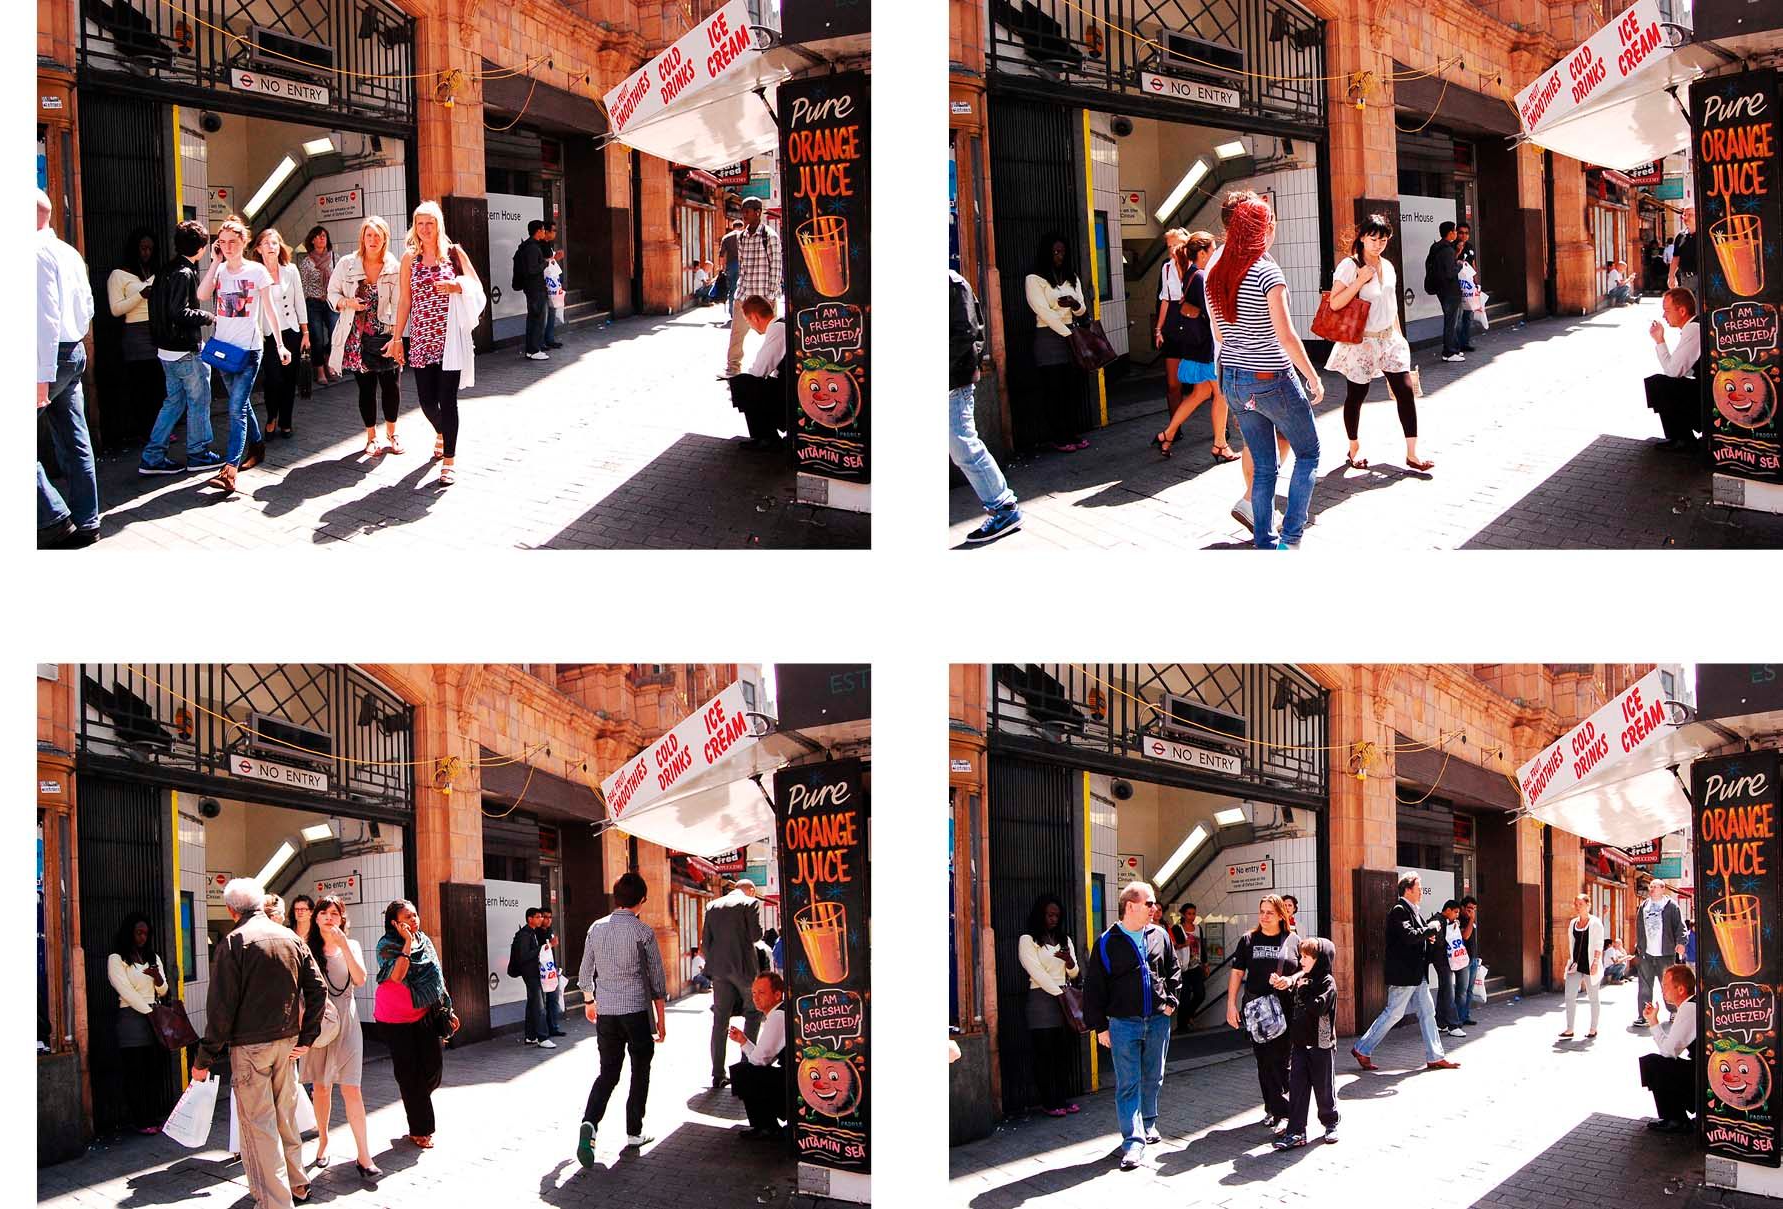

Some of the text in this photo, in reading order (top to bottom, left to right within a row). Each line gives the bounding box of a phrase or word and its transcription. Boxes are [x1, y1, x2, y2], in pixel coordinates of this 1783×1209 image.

[707, 13, 729, 48] ICE
[1618, 10, 1640, 46] ICE
[658, 47, 681, 81] COLD
[707, 25, 751, 78] CREAM
[1569, 46, 1592, 80] COLD
[1618, 23, 1662, 76] CREAM
[261, 78, 322, 100] NO ENTRY
[660, 58, 695, 104] DRINKS
[1171, 82, 1232, 104] NO ENTRY
[1572, 57, 1606, 103] DRINKS
[616, 71, 651, 130] SMOOTHIES
[792, 96, 854, 128] Pure
[1527, 71, 1562, 130] SMOOTHIES
[1704, 94, 1767, 126] Pure
[789, 126, 860, 163] ORANGE
[1702, 124, 1774, 162] ORANGE
[794, 163, 853, 197] JUICE
[1707, 161, 1766, 196] JUICE
[326, 196, 348, 205] No entry
[502, 211, 521, 221] House
[1414, 212, 1434, 223] House
[810, 318, 853, 331] FRESHLY
[823, 308, 838, 318] AM
[1725, 318, 1768, 330] FRESHLY
[1738, 308, 1752, 317] AM
[805, 328, 860, 345] SQUEEZED!
[1720, 327, 1776, 345] SQUEEZED!
[798, 446, 863, 468] VITAMIN SEA
[1714, 446, 1780, 469] VITAMIN SEA
[704, 700, 725, 734] ICE
[1621, 687, 1643, 723] ICE
[704, 712, 747, 764] CREAM
[1572, 722, 1595, 756] COLD
[1621, 700, 1665, 753] CREAM
[655, 734, 678, 768] COLD
[1173, 747, 1234, 770] NO ENTRY
[1574, 733, 1608, 779] DRINKS
[260, 764, 320, 787] NO ENTRY
[658, 745, 692, 790] DRINKS
[1528, 746, 1564, 806] SMOOTHIES
[613, 758, 648, 817] SMOOTHIES
[789, 782, 851, 814] Pure
[1705, 774, 1768, 805] Pure
[786, 812, 857, 850] ORANGE
[1702, 804, 1774, 842] ORANGE
[791, 849, 850, 883] JUICE
[1236, 866, 1258, 875] No entry
[1706, 841, 1766, 875] JUICE
[324, 882, 346, 890] No entry
[500, 897, 519, 907] House
[822, 995, 837, 1005] AM
[1721, 998, 1764, 1011] FRESHLY
[1734, 988, 1749, 998] AM
[804, 1015, 860, 1032] SQUEEZED!
[810, 1005, 853, 1018] FRESHLY
[1716, 1008, 1772, 1026] SQUEEZED!
[799, 1135, 865, 1158] VITAMIN SEA
[1707, 1128, 1773, 1151] VITAMIN SEA
